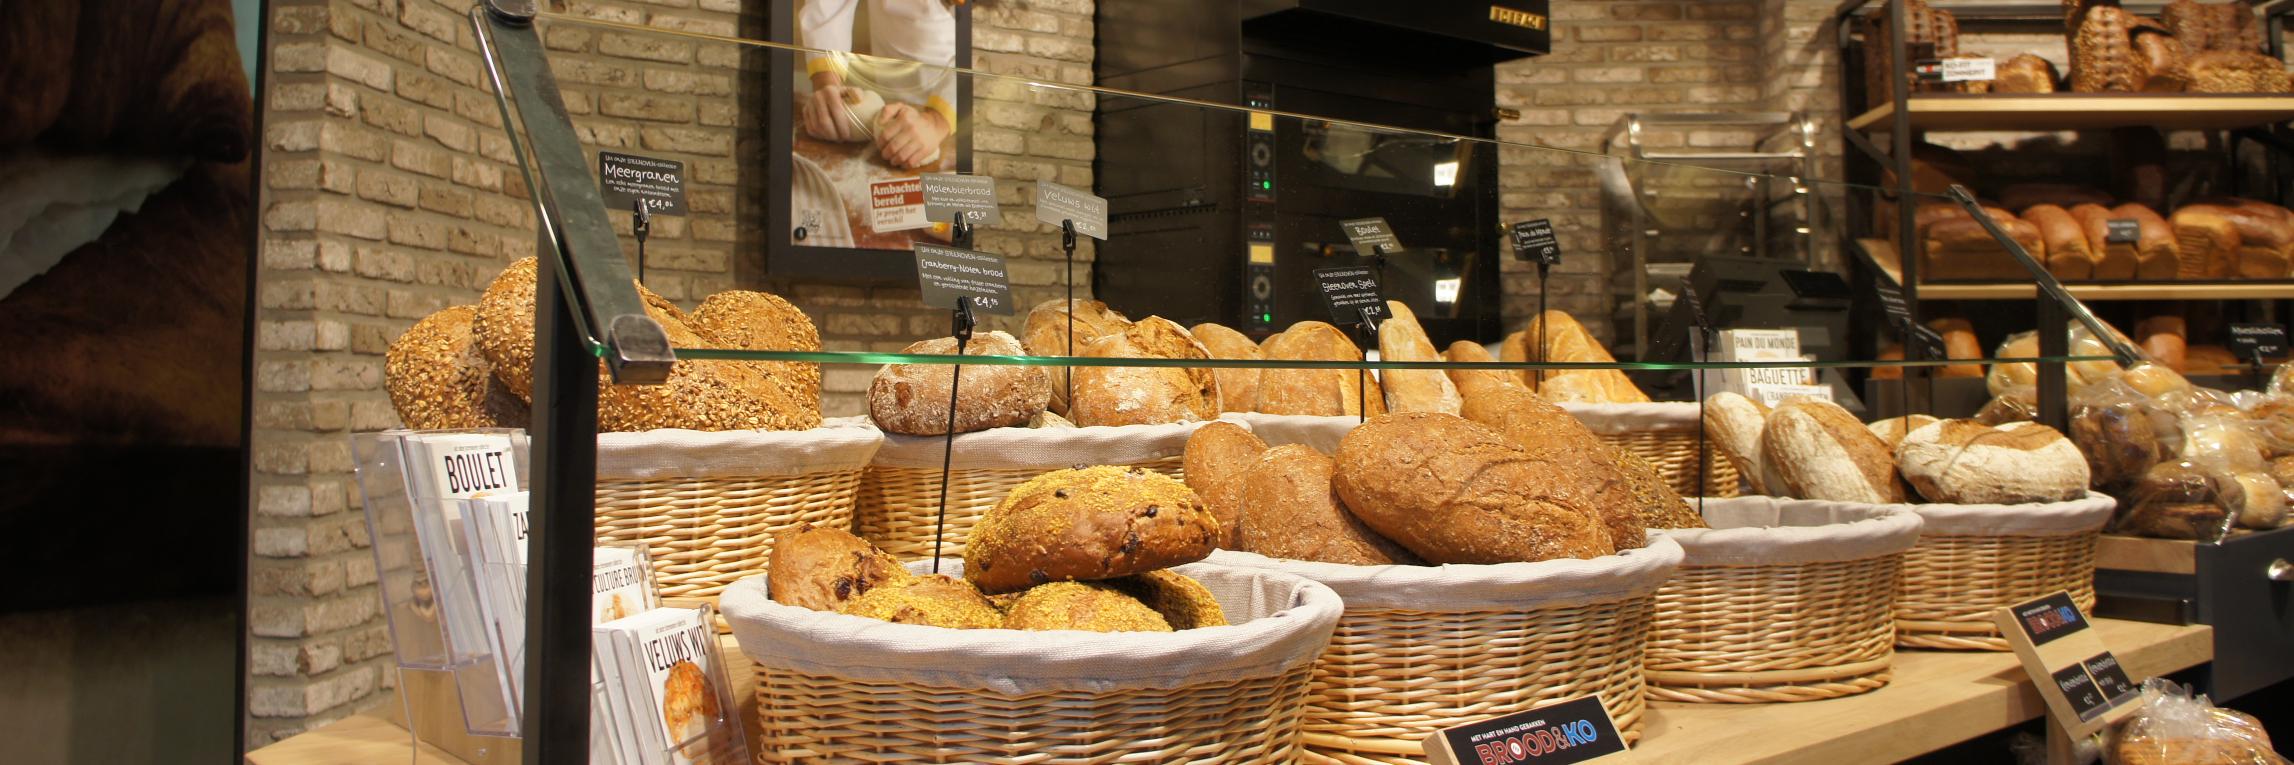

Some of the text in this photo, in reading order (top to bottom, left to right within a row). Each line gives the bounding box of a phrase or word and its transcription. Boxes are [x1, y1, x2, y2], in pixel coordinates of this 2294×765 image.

[605, 162, 679, 183] Meergranen
[874, 194, 904, 207] bereid
[922, 259, 1004, 278] Cranberry-Noten brood
[1736, 337, 1796, 349] PAIN DU MONDE
[1750, 368, 1806, 384] BAGUETTE
[444, 452, 507, 494] BOULET
[594, 569, 624, 594] CULTURE
[644, 630, 691, 672] VELUWS
[1482, 732, 1496, 740] HART
[1504, 726, 1520, 734] HAND
